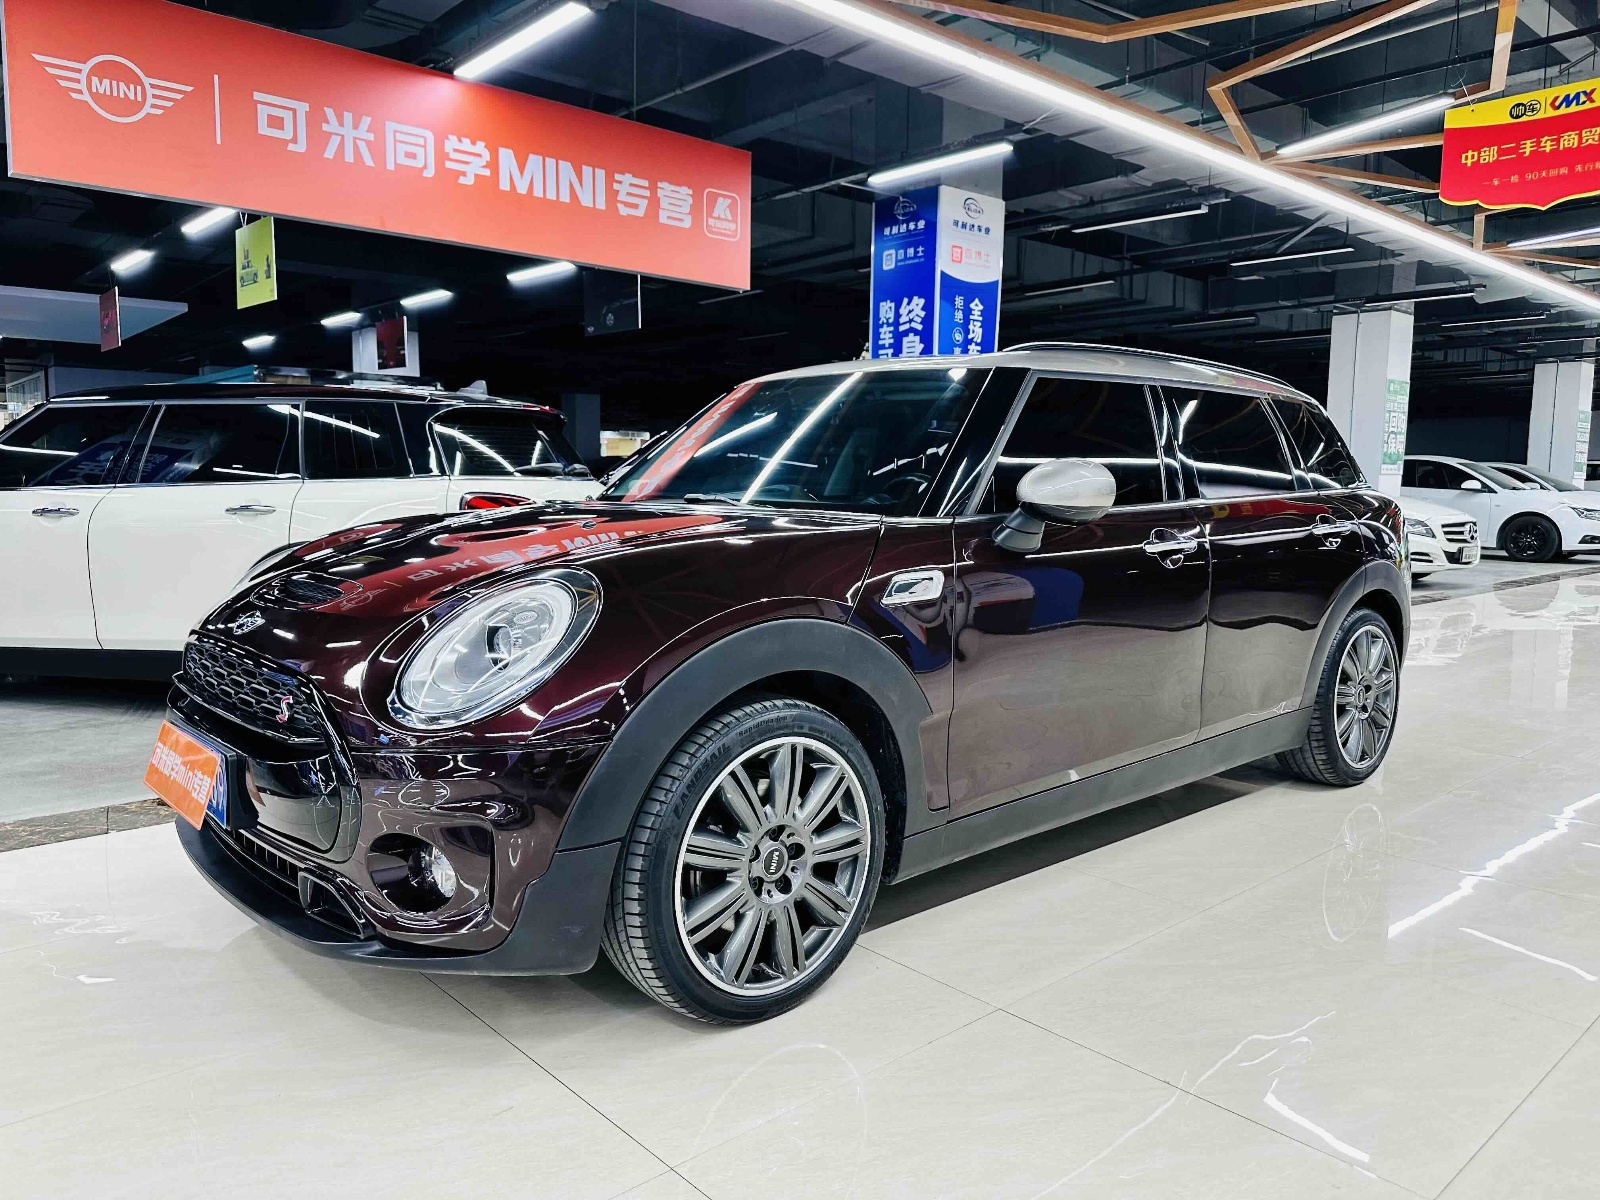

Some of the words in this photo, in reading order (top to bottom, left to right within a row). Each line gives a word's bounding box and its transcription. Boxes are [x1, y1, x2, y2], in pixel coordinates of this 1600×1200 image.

[91, 76, 142, 102] MINI
[1461, 127, 1600, 167] 中部二手车商贸
[1525, 166, 1568, 181] 90天回购
[899, 296, 926, 357] 终身
[276, 696, 293, 723] S
[672, 742, 731, 820] LANDSAIL
[769, 851, 780, 873] MINI
